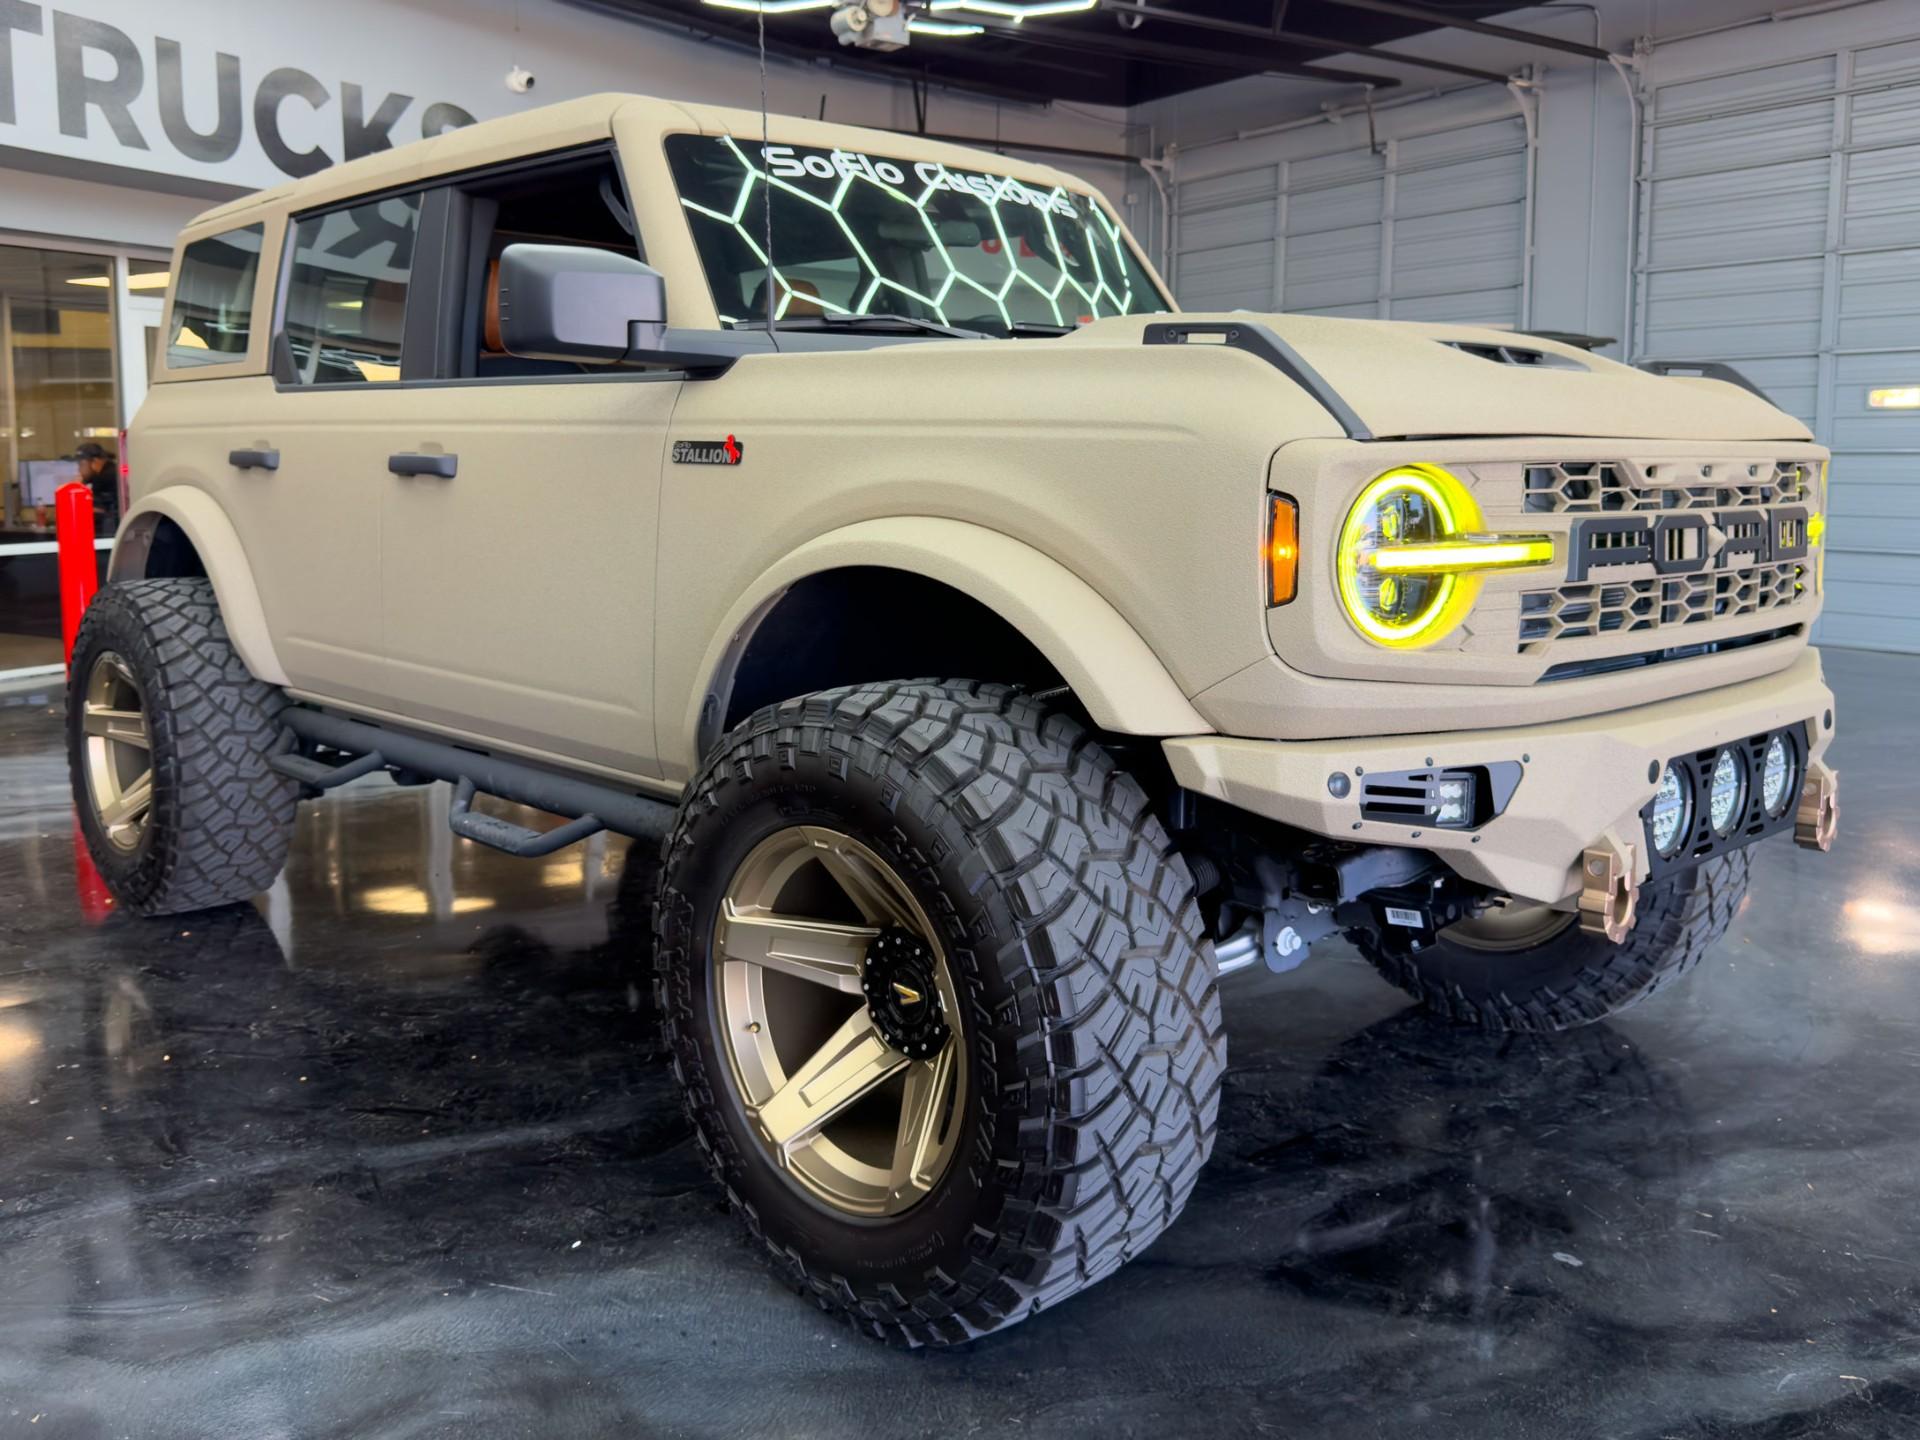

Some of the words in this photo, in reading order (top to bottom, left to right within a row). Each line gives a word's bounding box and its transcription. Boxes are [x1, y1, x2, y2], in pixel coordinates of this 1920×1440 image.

[761, 147, 905, 185] SoFlo
[914, 161, 1078, 219] Customs
[672, 447, 732, 464] STALLION
[1565, 507, 1808, 582] FORD
